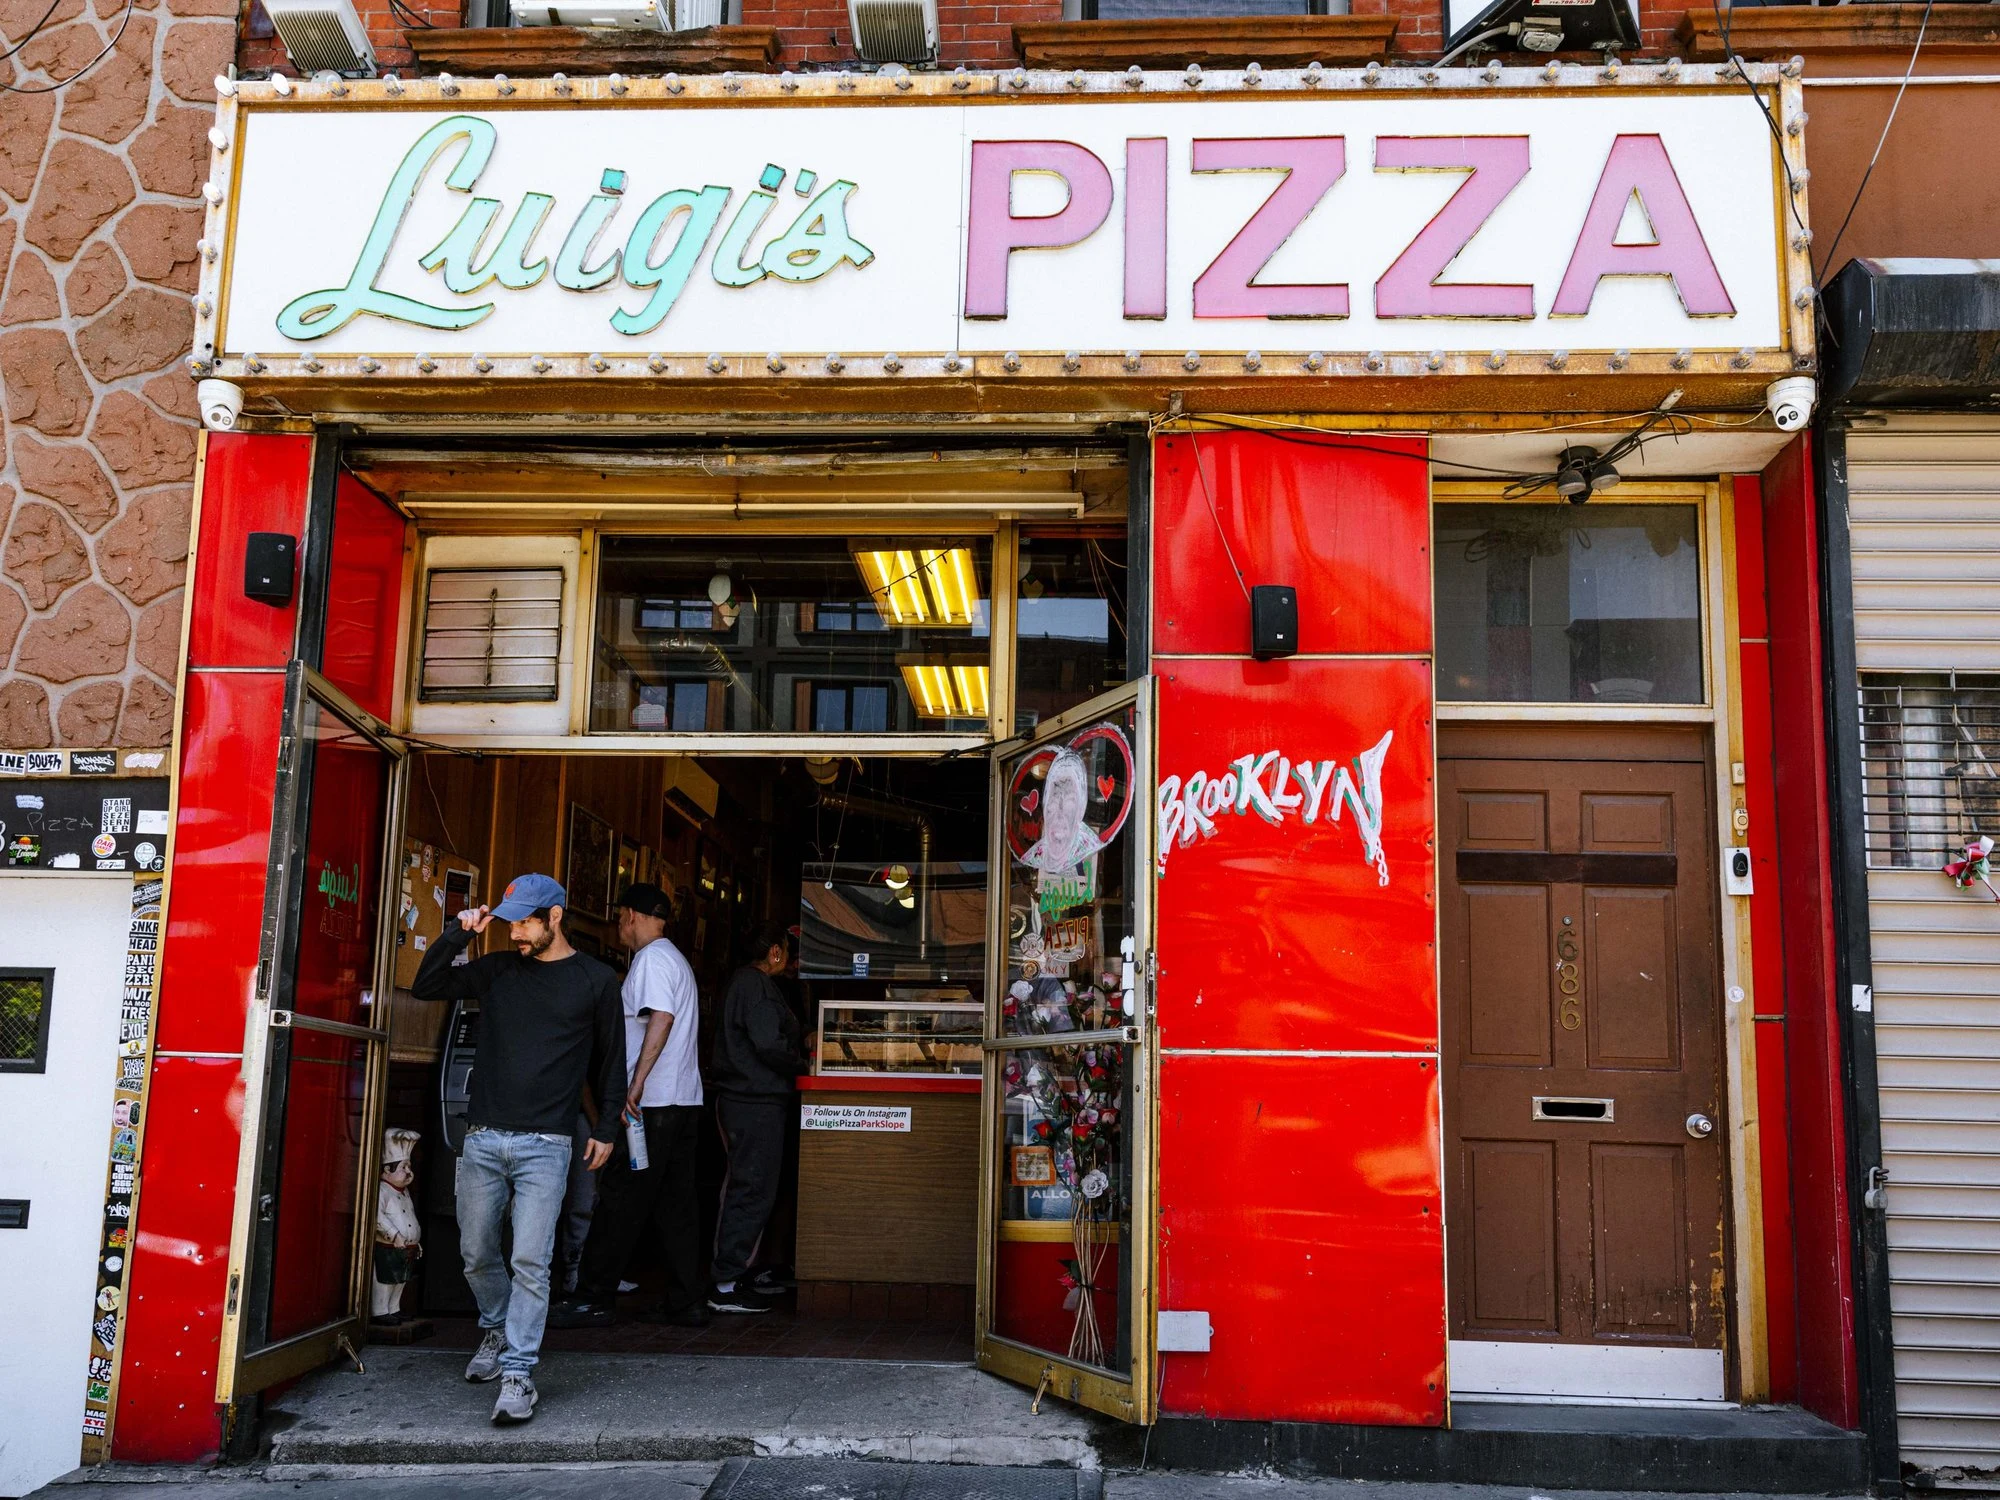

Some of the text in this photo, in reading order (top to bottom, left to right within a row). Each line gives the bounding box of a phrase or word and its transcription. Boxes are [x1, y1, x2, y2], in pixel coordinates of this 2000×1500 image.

[276, 115, 1738, 341] Luigi's PIZZA
[813, 1108, 907, 1119] Follow Us On Instagram
[805, 1118, 905, 1130] @LuigisPizzaParkSlope
